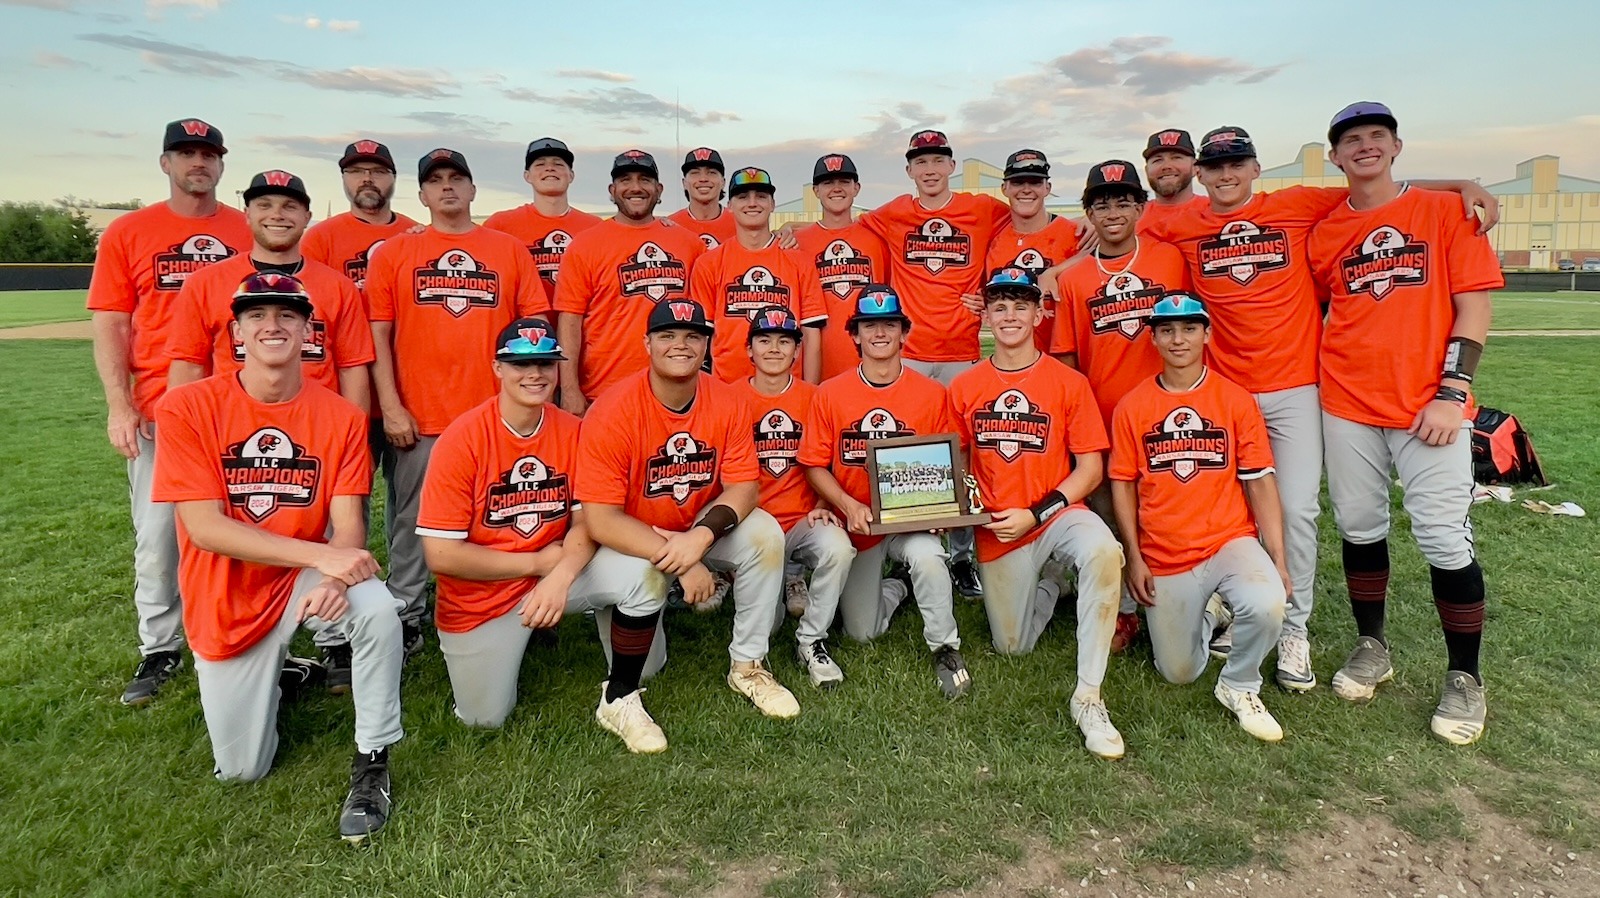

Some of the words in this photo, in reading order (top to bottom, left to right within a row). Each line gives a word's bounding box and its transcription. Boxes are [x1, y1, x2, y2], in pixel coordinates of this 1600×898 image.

[181, 120, 210, 137] W
[354, 140, 379, 154] W
[1158, 132, 1182, 146] W
[693, 148, 712, 161] W
[824, 156, 844, 172] W
[262, 172, 292, 187] W
[1100, 164, 1126, 182] W
[906, 240, 968, 253] CHAMPIONS
[1201, 239, 1285, 263] CHAMPIONS
[622, 267, 685, 283] CHAMPIONS
[818, 264, 870, 277] HAMPIONS
[417, 276, 496, 292] CHAMPIONS
[727, 291, 788, 306] CHAMPIONS
[668, 302, 694, 322] W
[1091, 296, 1158, 320] CHAMPION
[765, 310, 788, 327] W
[974, 420, 1046, 437] CHAMPIONS
[1146, 438, 1224, 456] CHAMPIONS
[225, 467, 315, 487] HAMPIONS
[649, 458, 714, 483] CHAMPIONS
[251, 499, 270, 508] 2024
[489, 485, 566, 511] CHAMPIONS
